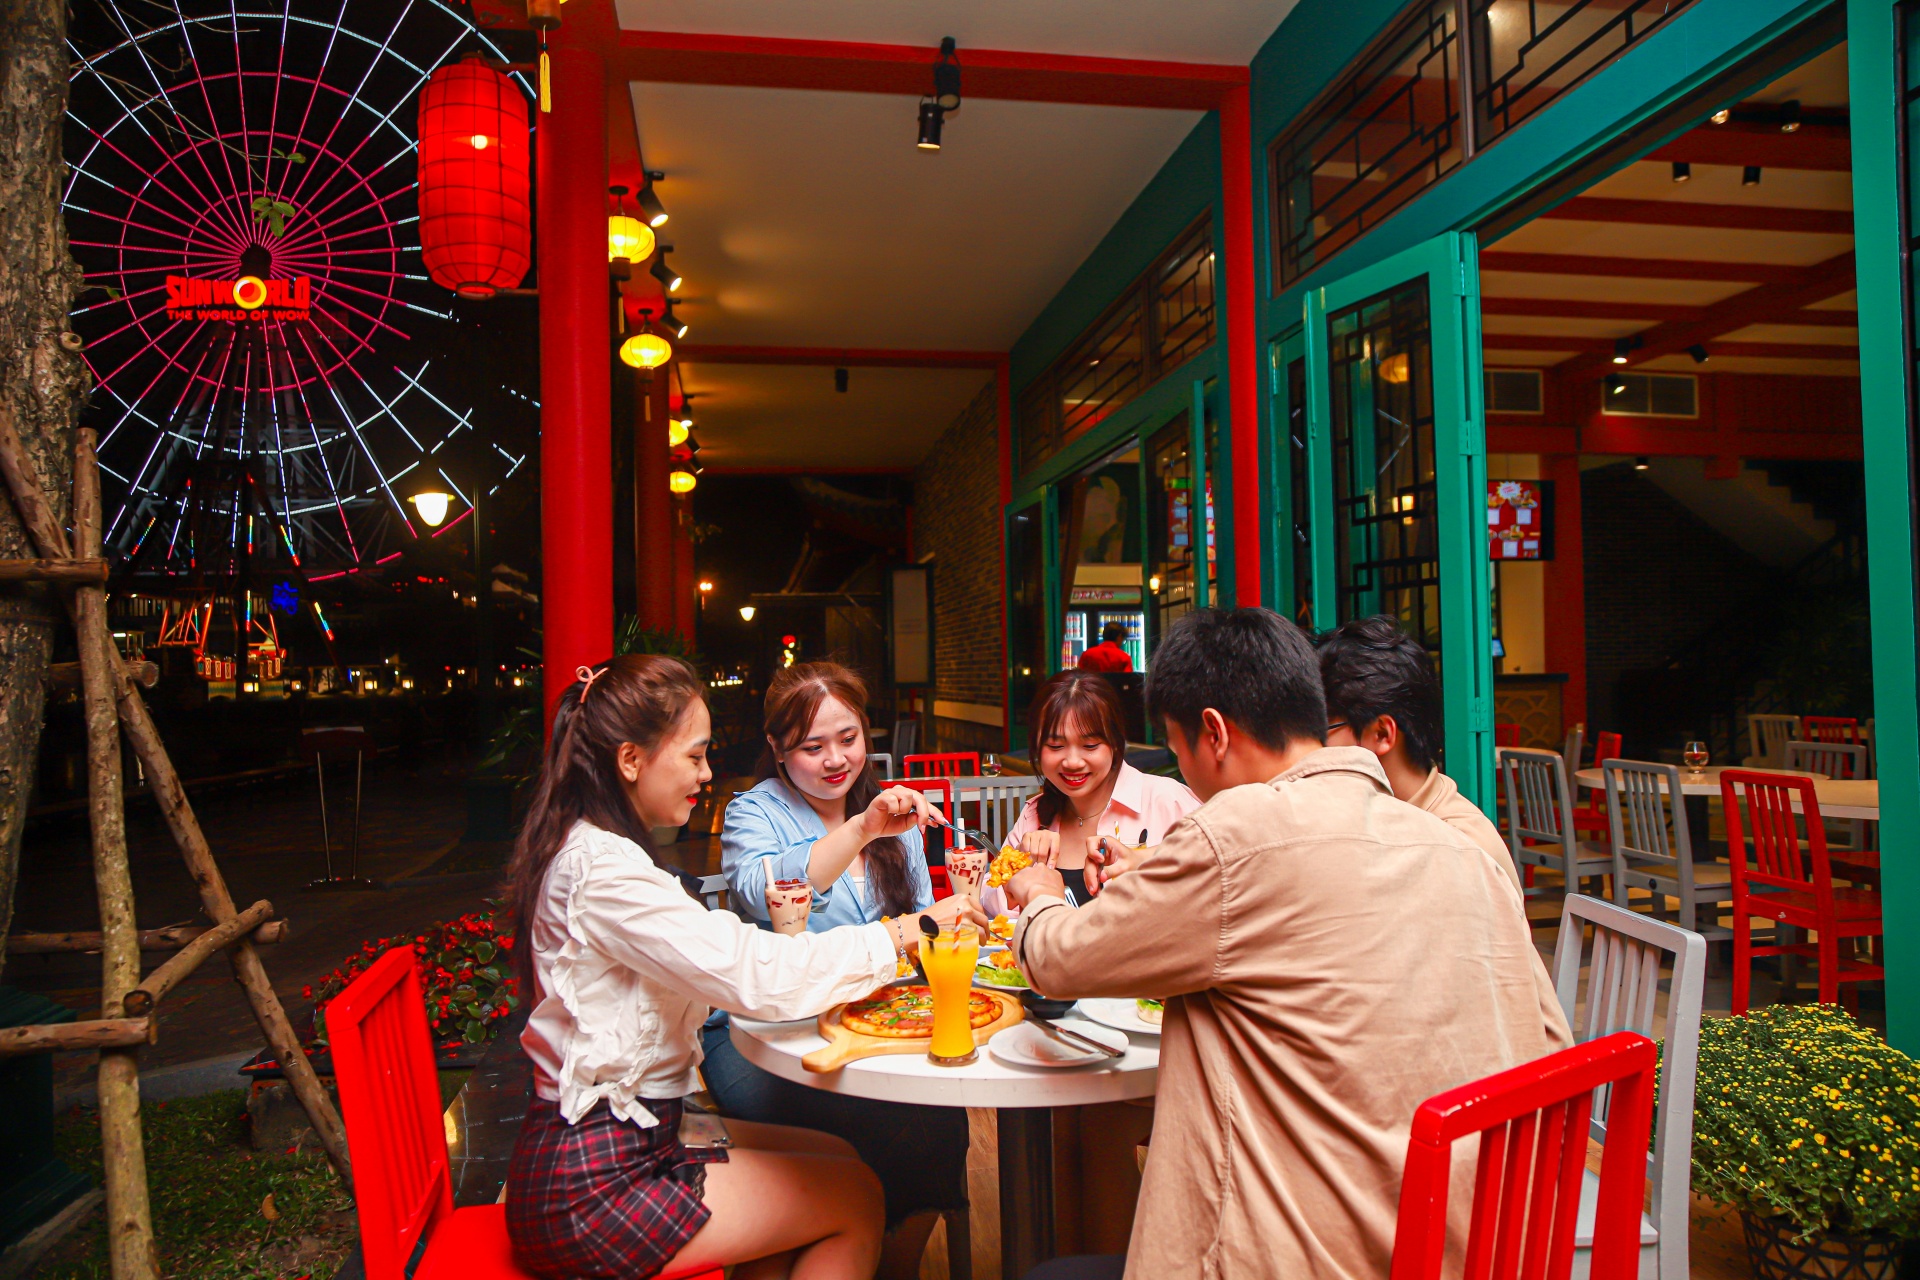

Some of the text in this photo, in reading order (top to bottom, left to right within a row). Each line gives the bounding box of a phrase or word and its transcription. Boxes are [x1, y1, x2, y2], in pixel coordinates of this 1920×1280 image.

[167, 310, 310, 320] THE WORLD OF WOW
